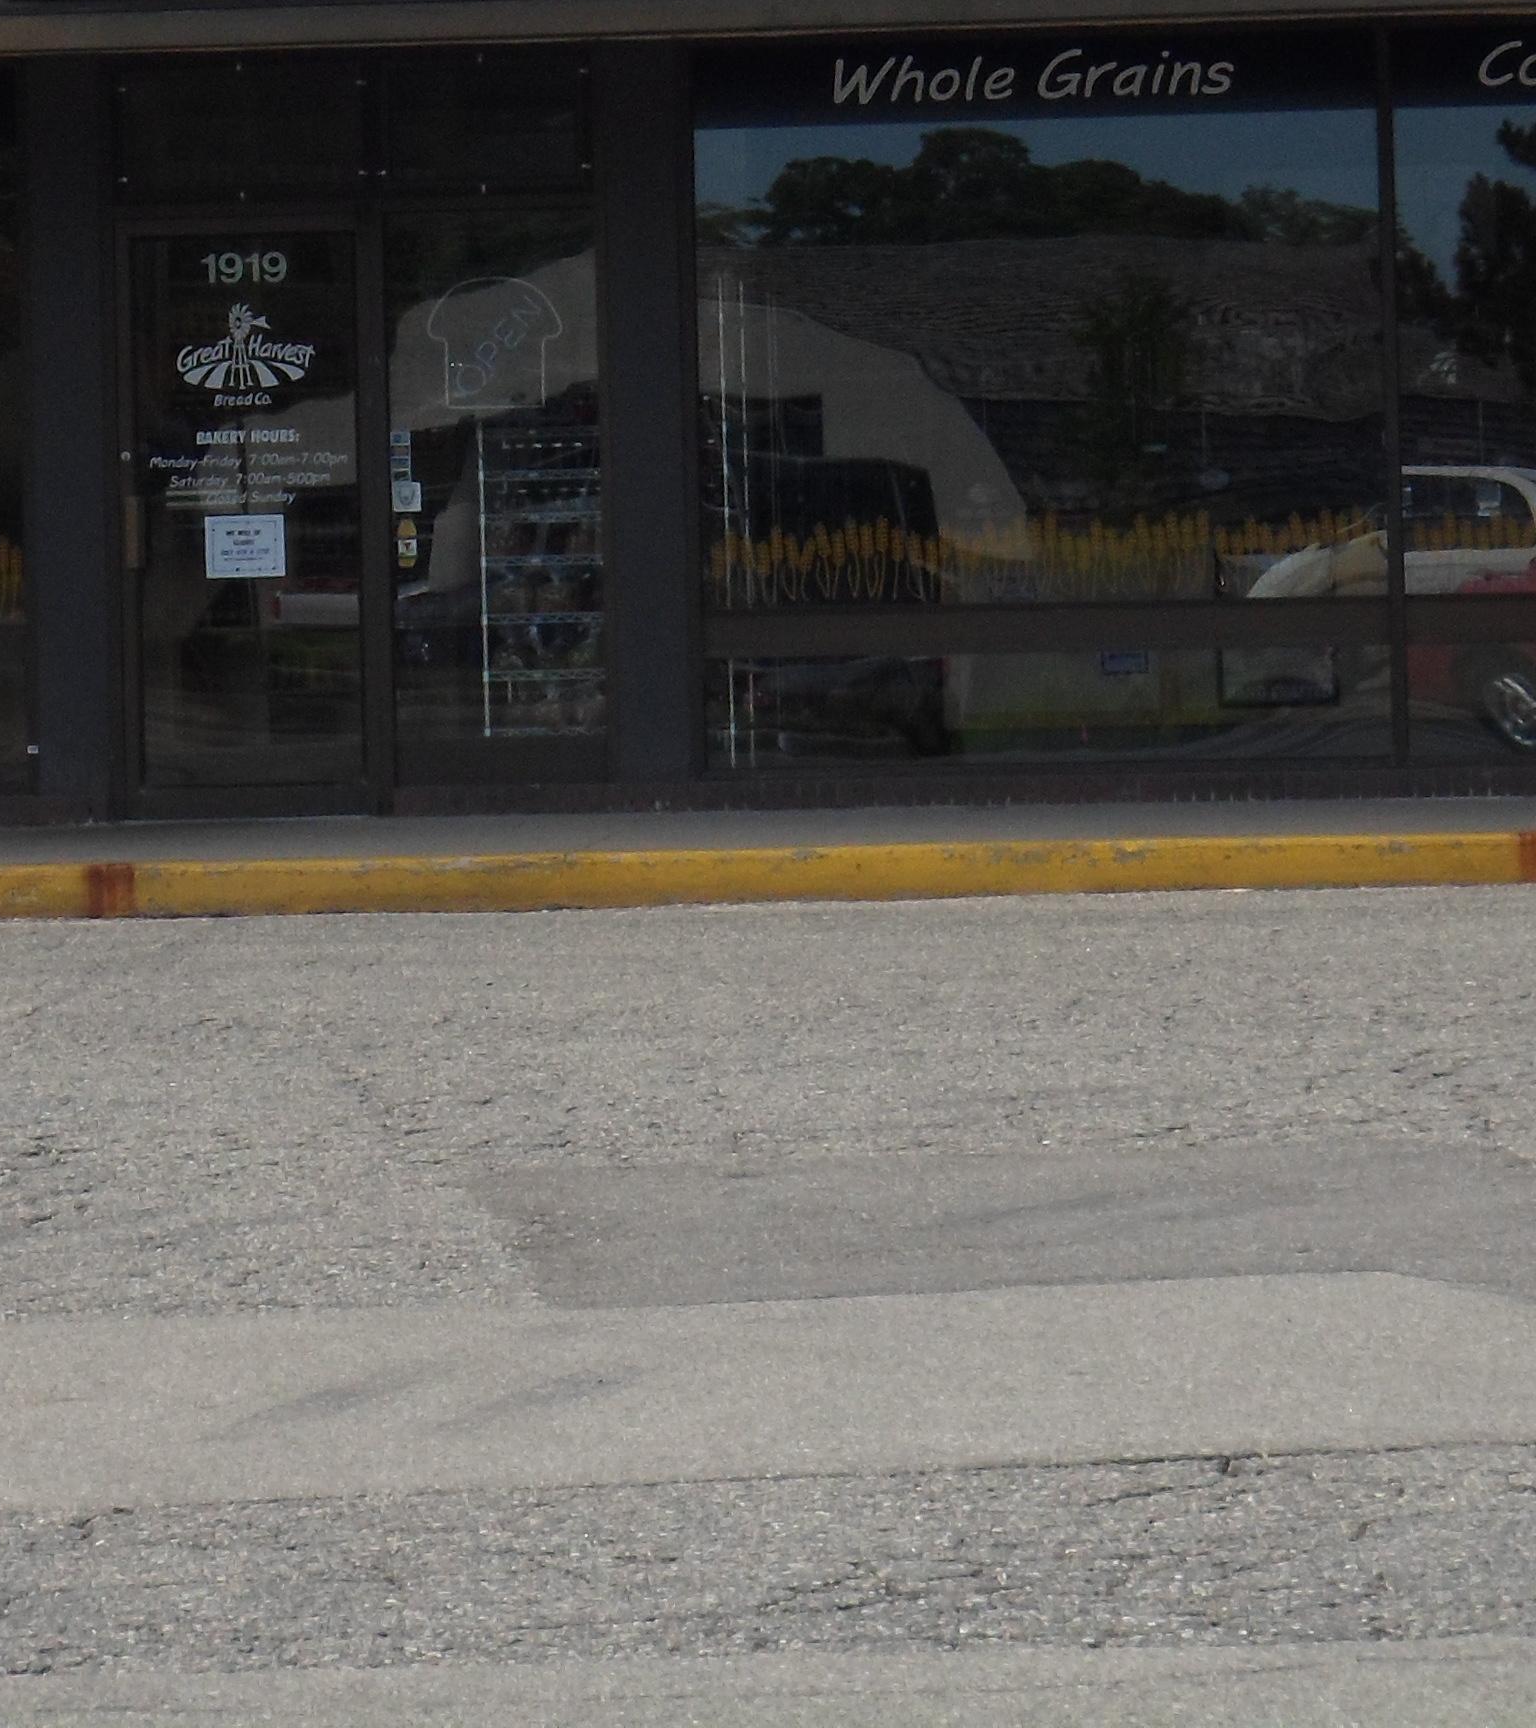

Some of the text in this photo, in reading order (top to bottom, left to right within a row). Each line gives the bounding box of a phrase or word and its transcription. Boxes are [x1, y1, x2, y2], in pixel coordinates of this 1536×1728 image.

[833, 48, 1235, 105] Whole Grains
[200, 251, 288, 283] 1919
[176, 333, 316, 373] Great Harvest
[214, 393, 253, 406] Bread
[196, 431, 245, 445] BAKERY
[170, 474, 229, 488] Saturday
[252, 490, 297, 505] Sunday
